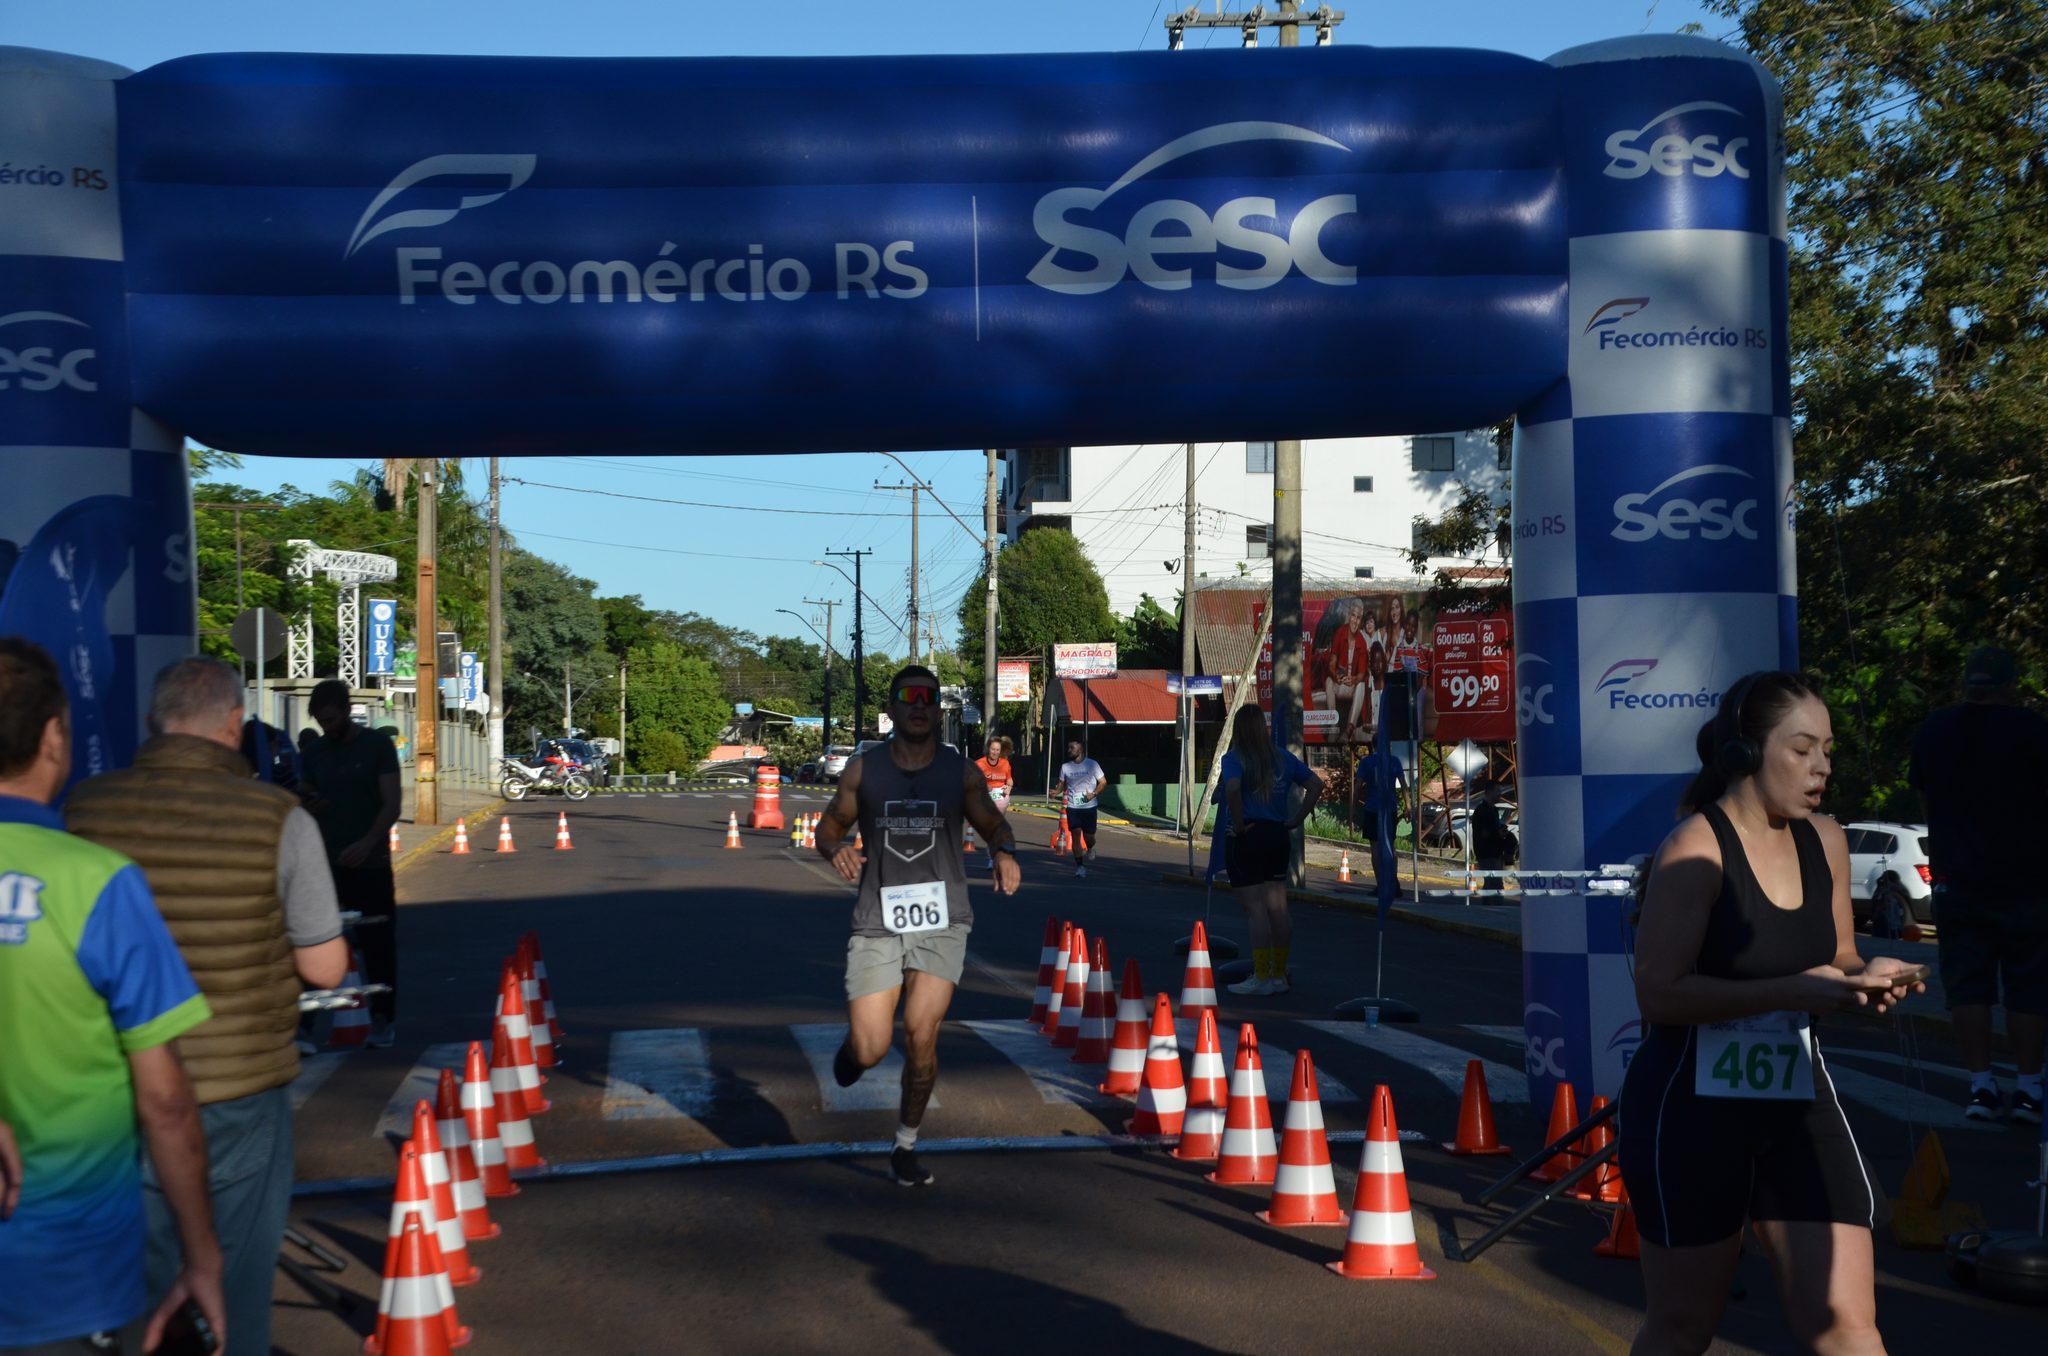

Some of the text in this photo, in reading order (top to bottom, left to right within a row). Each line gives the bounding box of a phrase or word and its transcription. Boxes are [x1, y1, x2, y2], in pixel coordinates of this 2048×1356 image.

[73, 167, 108, 190] RS
[395, 240, 929, 304] Fecomércio RS
[1599, 326, 1768, 350] Fecomércio RS
[1542, 515, 1566, 536] RS
[374, 623, 391, 672] URI
[1437, 633, 1476, 645] 600 MEGA
[1483, 632, 1494, 643] 60
[1060, 647, 1112, 658] MAGRÃO
[462, 668, 473, 700] URI
[892, 901, 941, 929] 806
[1712, 1041, 1799, 1091] 467
